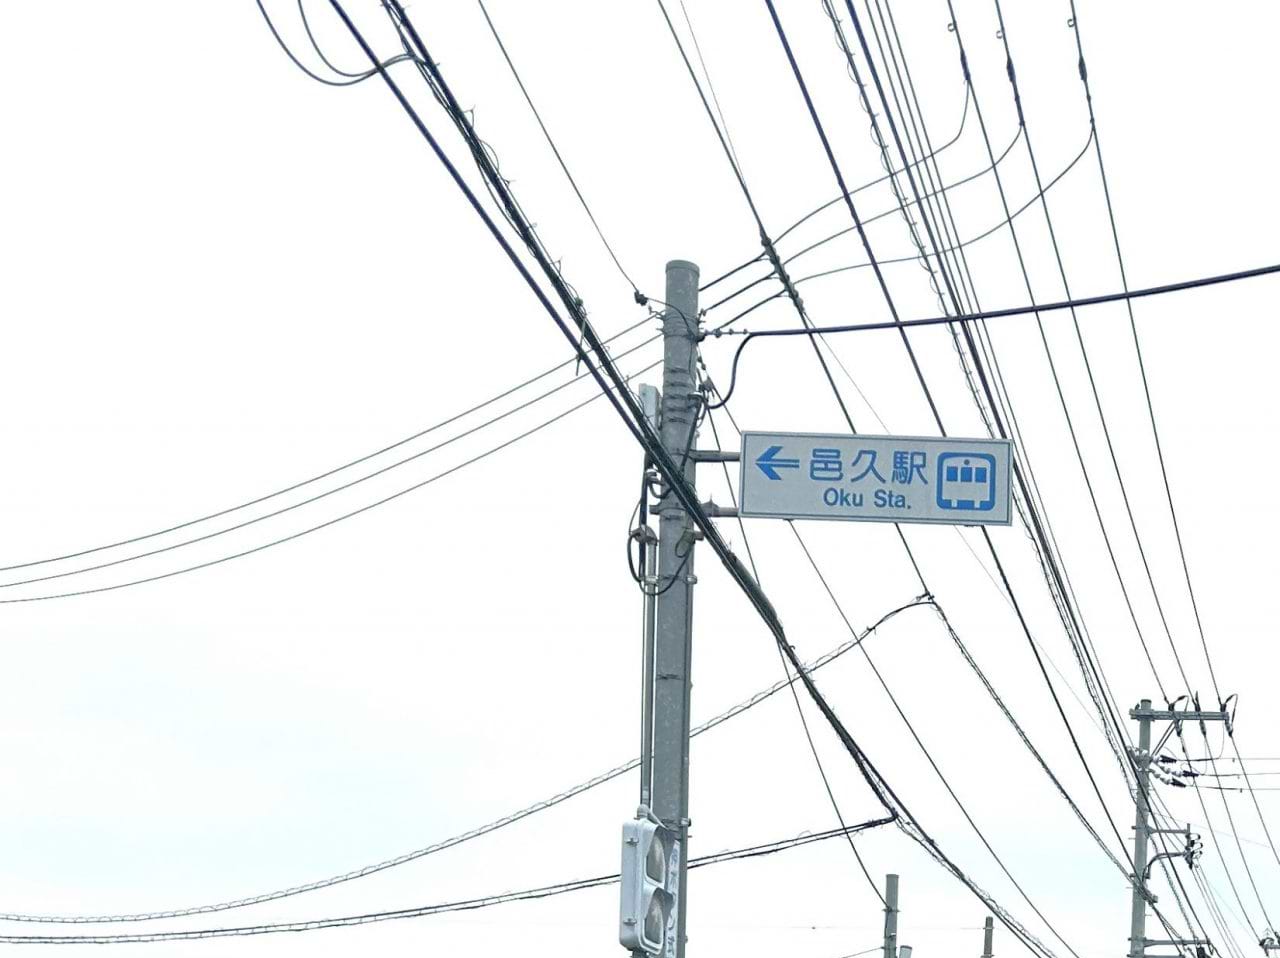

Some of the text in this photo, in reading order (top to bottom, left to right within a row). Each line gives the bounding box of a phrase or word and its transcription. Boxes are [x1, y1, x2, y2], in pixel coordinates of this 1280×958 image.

[809, 448, 928, 485] 邑久駅
[823, 487, 912, 510] Oku Sta.
